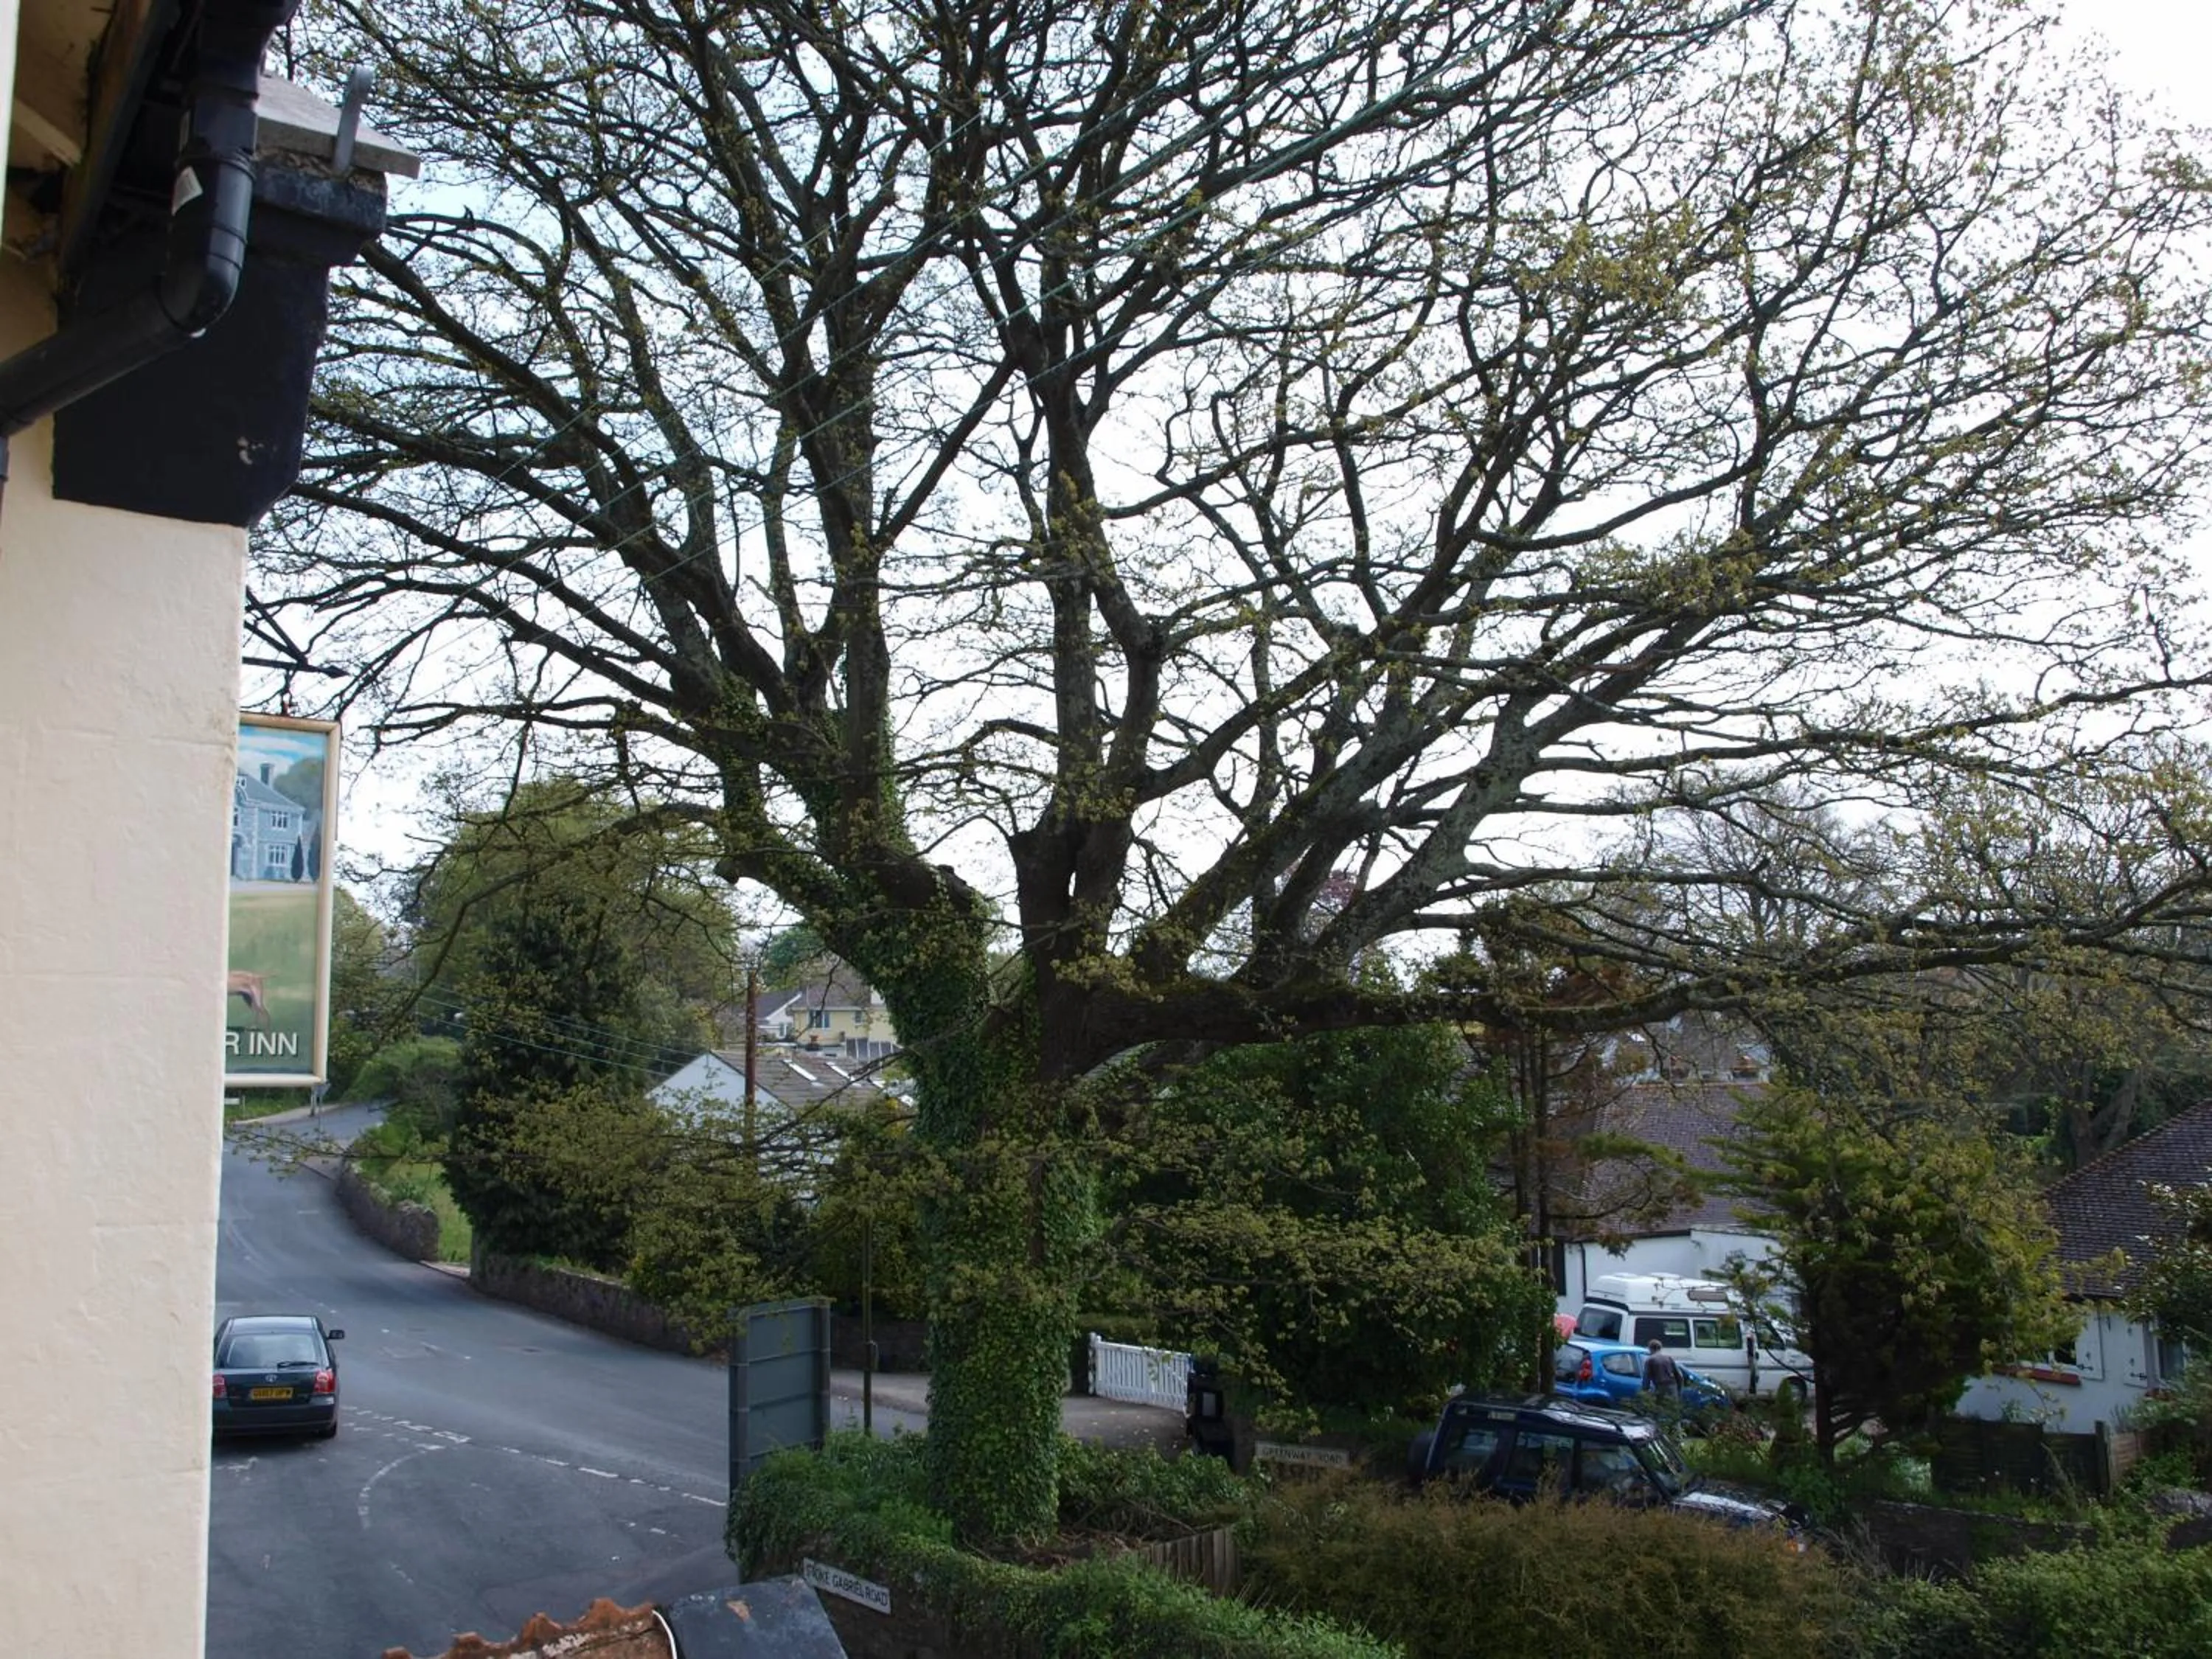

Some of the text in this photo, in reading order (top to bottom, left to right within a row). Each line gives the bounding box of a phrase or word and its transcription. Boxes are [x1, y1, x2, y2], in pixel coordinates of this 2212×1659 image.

[249, 1032, 297, 1056] INN
[832, 1573, 864, 1599] GABRIEL
[864, 1586, 888, 1607] ROAD
